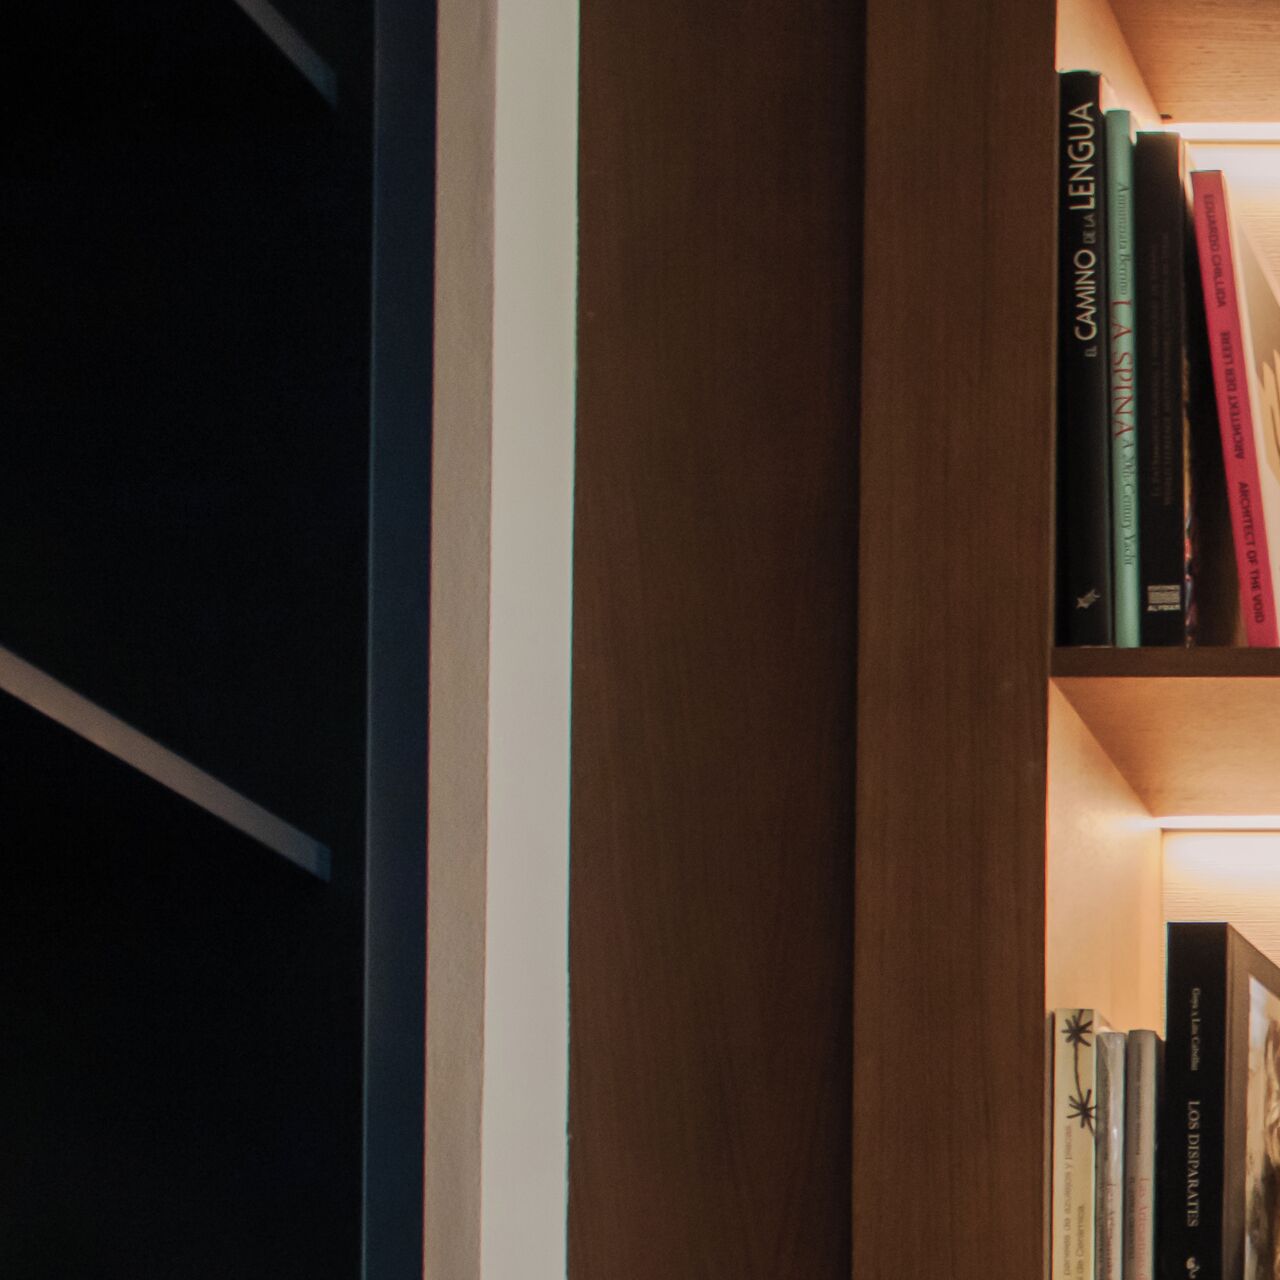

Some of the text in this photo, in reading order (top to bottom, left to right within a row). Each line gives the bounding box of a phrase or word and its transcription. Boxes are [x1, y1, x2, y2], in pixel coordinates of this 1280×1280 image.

[1067, 101, 1097, 211] LENGUA
[1083, 212, 1097, 227] LA
[1083, 230, 1097, 244] DE
[1203, 194, 1226, 308] EDUARDO CHILLIDA
[1073, 249, 1098, 341] CAMINO
[1111, 299, 1134, 438] LA SPINA
[1220, 331, 1245, 460] ARCHITEKT DER LEERE
[1123, 535, 1136, 566] Yacht
[1239, 481, 1265, 624] ARCHITECT OF THE VOID
[1186, 1100, 1200, 1228] LOS DISPARATES
